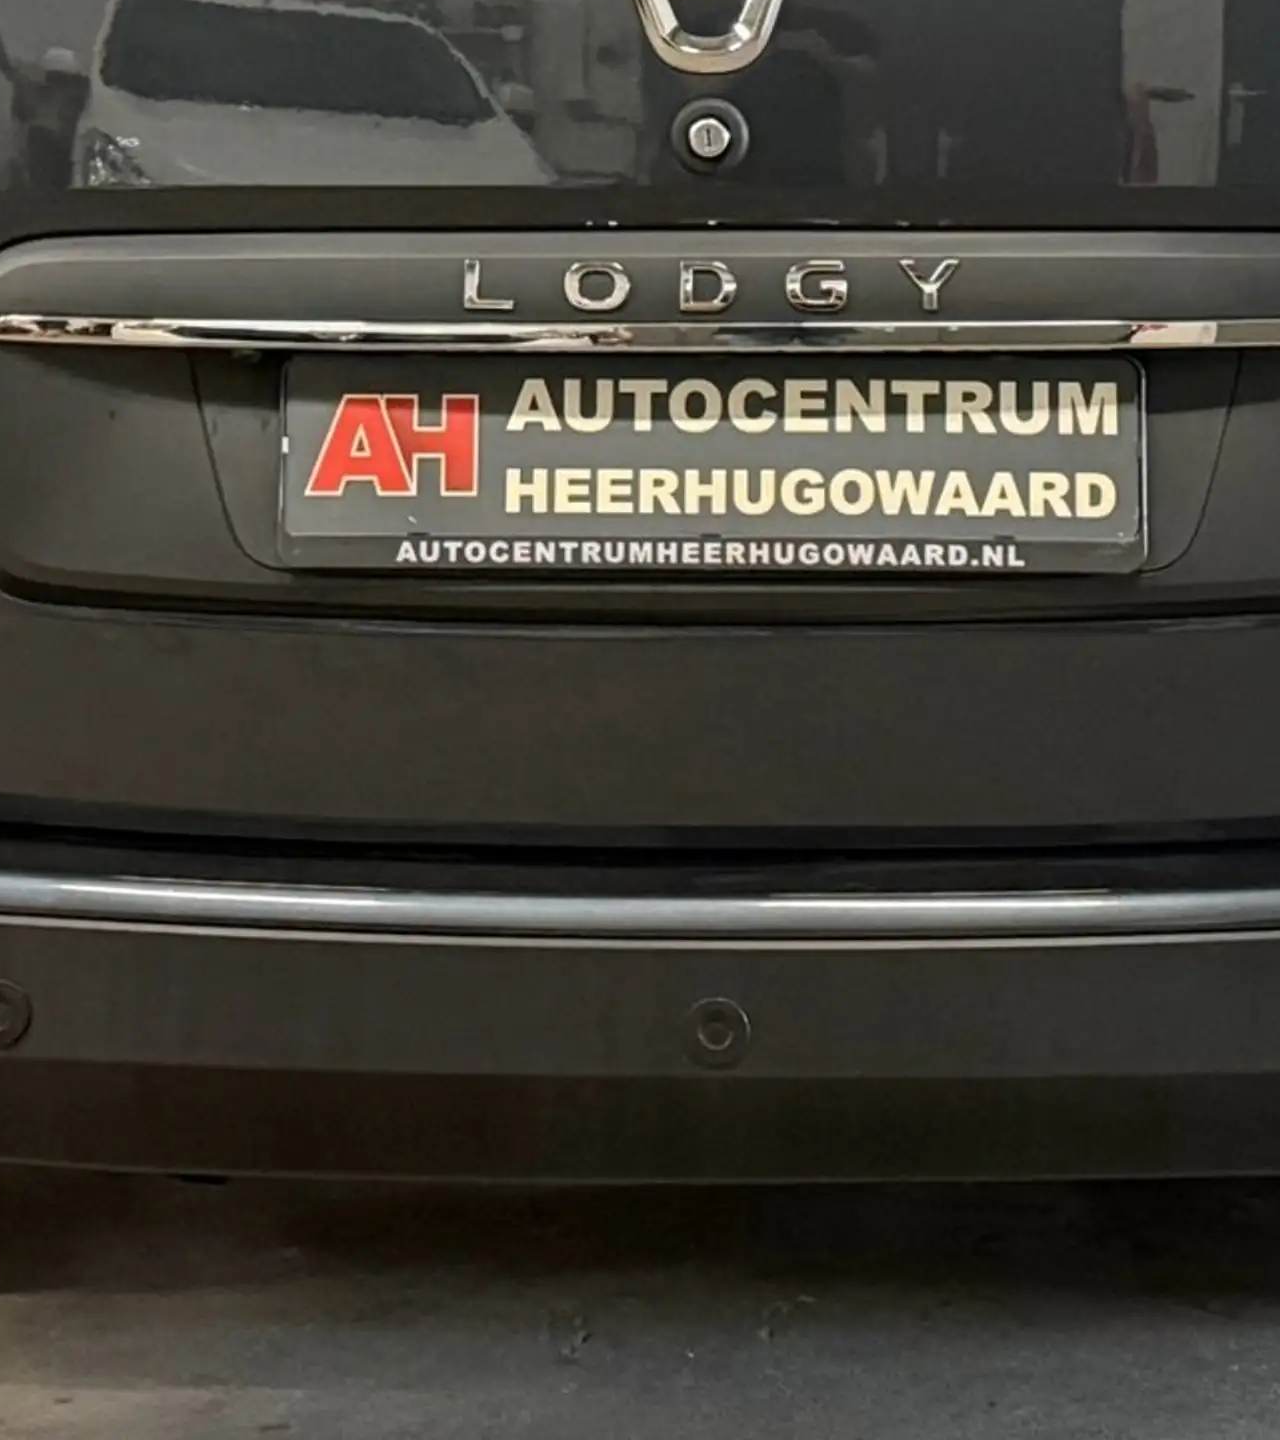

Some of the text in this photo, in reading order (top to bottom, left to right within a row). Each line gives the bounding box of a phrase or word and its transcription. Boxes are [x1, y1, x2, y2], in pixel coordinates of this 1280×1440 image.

[463, 259, 959, 311] LODGY
[506, 378, 1118, 435] AUTOCENTRUM
[305, 393, 479, 498] AH
[505, 468, 1116, 518] HEERHUGOWAARD
[396, 539, 1026, 568] AUTOCENTRUMHEERHUGOWAARD.NL
